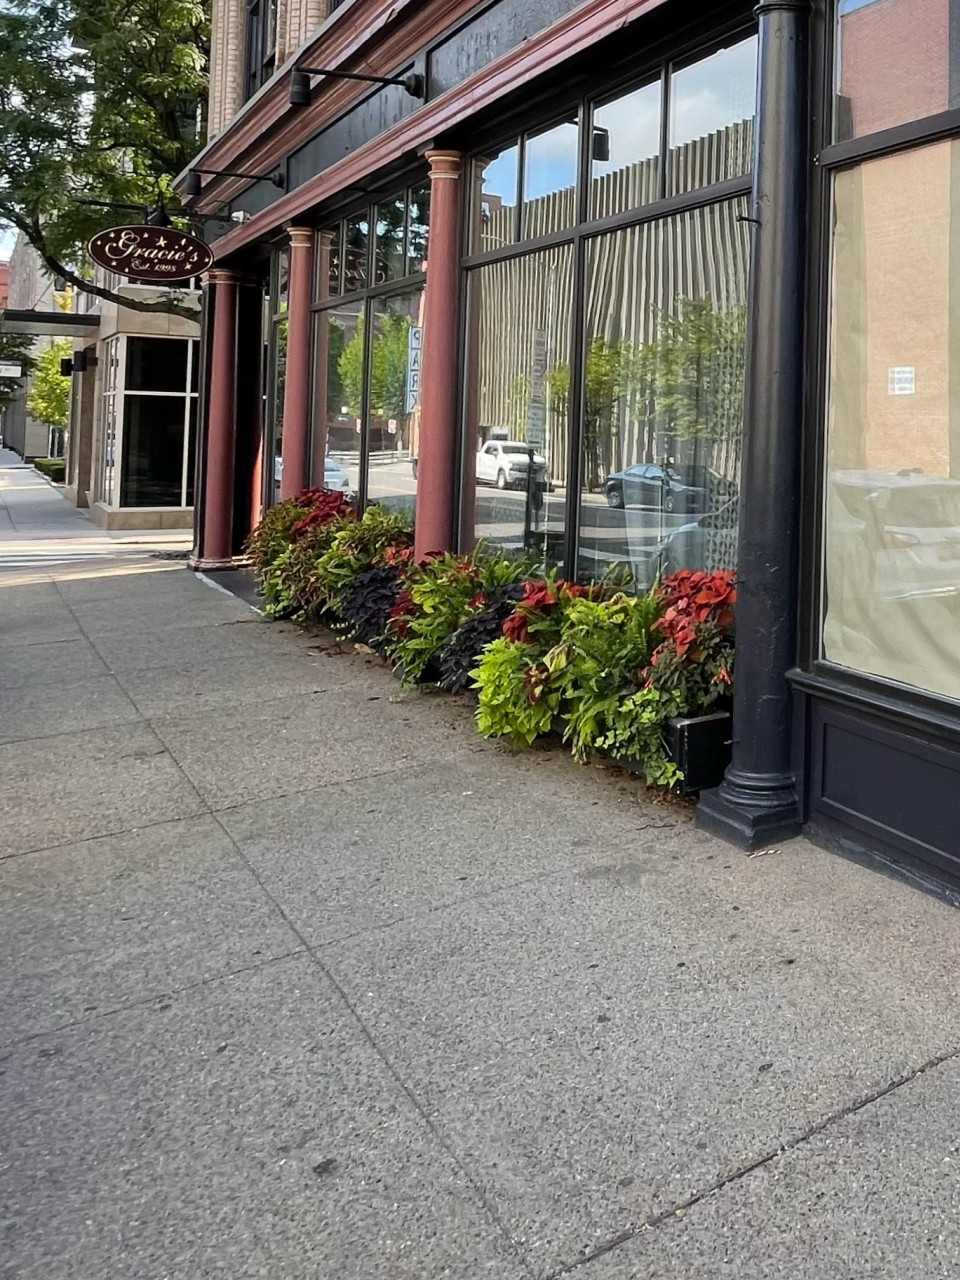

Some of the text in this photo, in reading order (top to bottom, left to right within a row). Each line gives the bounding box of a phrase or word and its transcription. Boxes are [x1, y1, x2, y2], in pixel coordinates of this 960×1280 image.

[105, 230, 199, 262] Gracie's
[131, 258, 178, 272] Est. 1998
